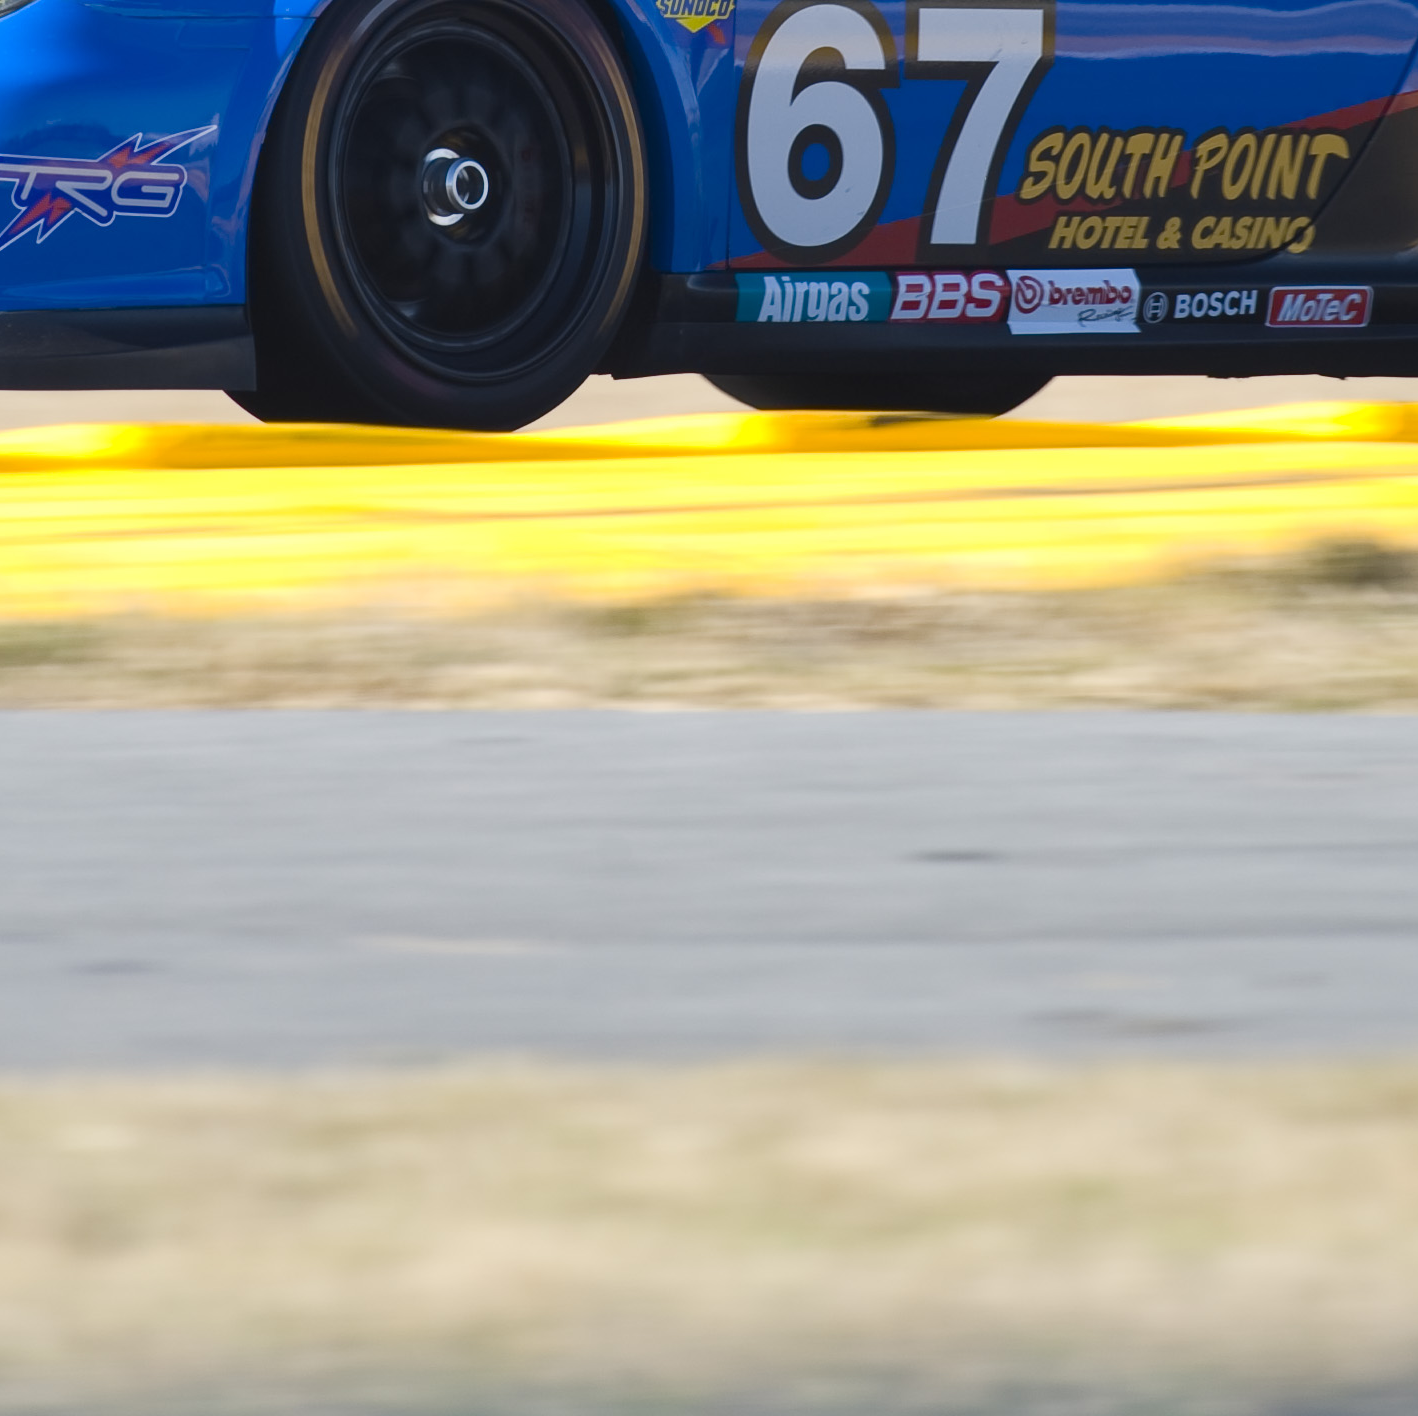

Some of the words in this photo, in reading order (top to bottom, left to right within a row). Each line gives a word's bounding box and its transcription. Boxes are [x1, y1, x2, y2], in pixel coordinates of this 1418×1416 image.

[747, 3, 1044, 246] 67
[1019, 131, 1183, 200] SOUTH
[1190, 132, 1350, 201] POINT
[1048, 216, 1150, 250] HOTEL
[1155, 216, 1183, 250] &
[1191, 216, 1316, 254] CASINO
[756, 275, 871, 323] Airgas
[890, 273, 1005, 320] BBS
[1047, 279, 1134, 306] brembo
[1173, 290, 1258, 319] BOSCH
[1277, 292, 1363, 322] MoTeC
